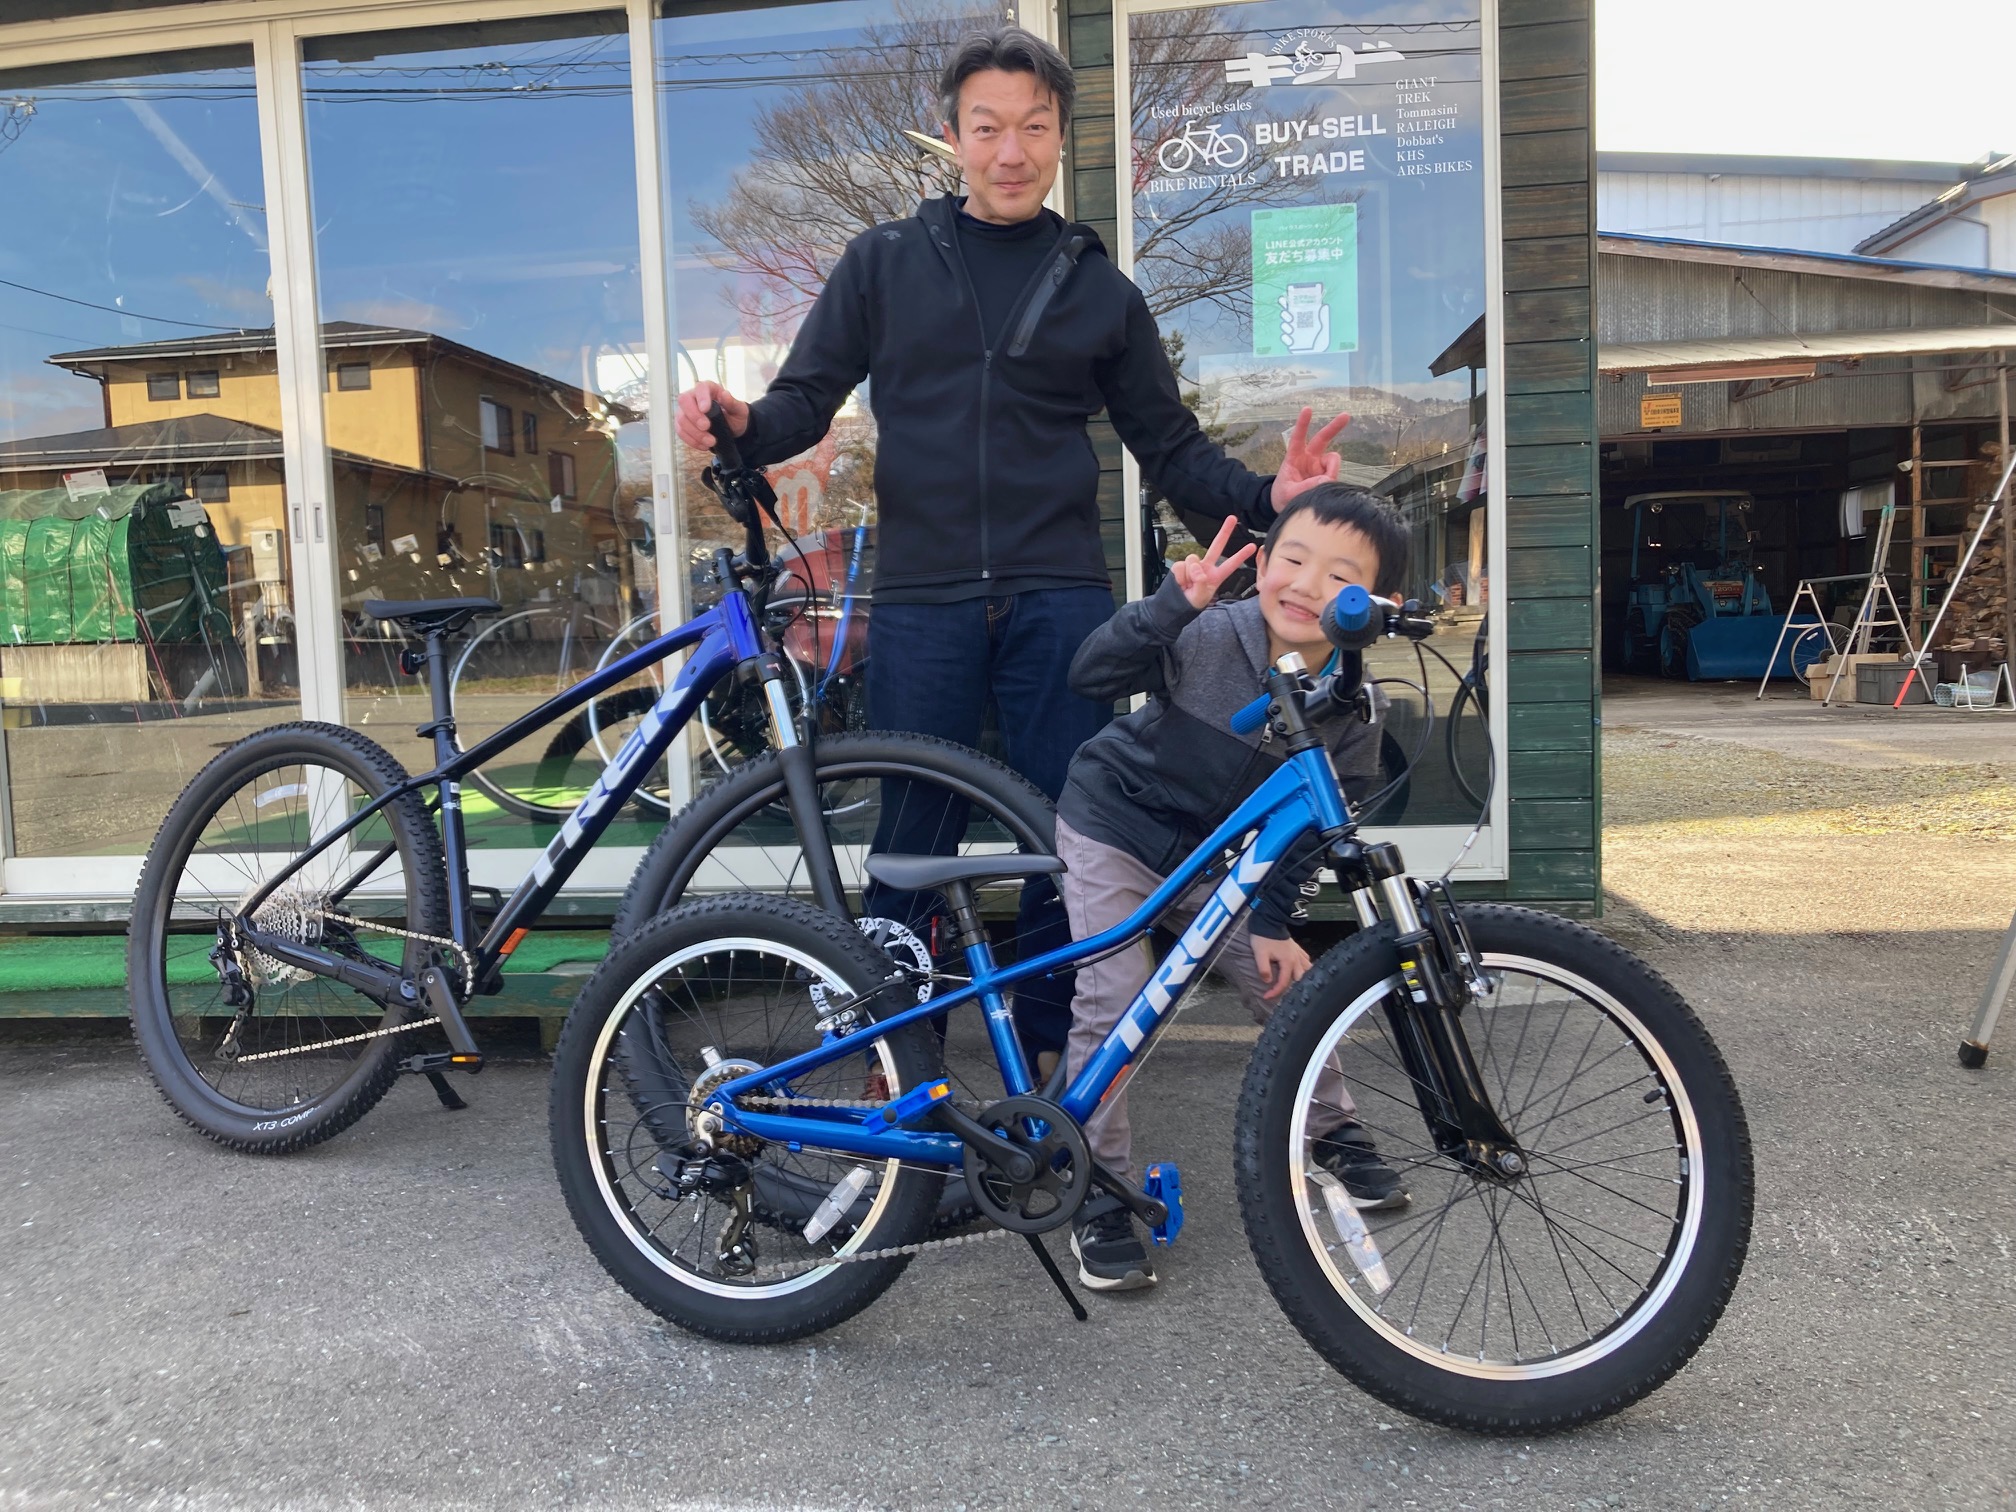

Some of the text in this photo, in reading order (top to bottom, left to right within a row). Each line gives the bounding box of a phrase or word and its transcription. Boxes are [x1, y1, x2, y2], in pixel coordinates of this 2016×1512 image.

[1271, 28, 1337, 55] BIKE SPORTS
[1396, 76, 1438, 91] GIANT
[1396, 91, 1431, 105] TREK
[1151, 99, 1252, 119] Used bicycle sales
[1396, 103, 1458, 119] Tommasini
[1396, 118, 1456, 134] RALEIGH
[1397, 134, 1444, 148] Dobbat's
[1274, 149, 1365, 178] TRADE
[1397, 149, 1425, 162] KHS
[1397, 160, 1473, 177] ARES BIKES
[1150, 171, 1256, 193] BIKE RENTALS
[1265, 236, 1343, 250] LINE公式アカウント
[1265, 246, 1344, 265] 友だち募集中
[533, 670, 690, 888] TREK
[1103, 838, 1275, 1054] TREK
[252, 1121, 278, 1131] XT3
[280, 1107, 314, 1127] COMP
